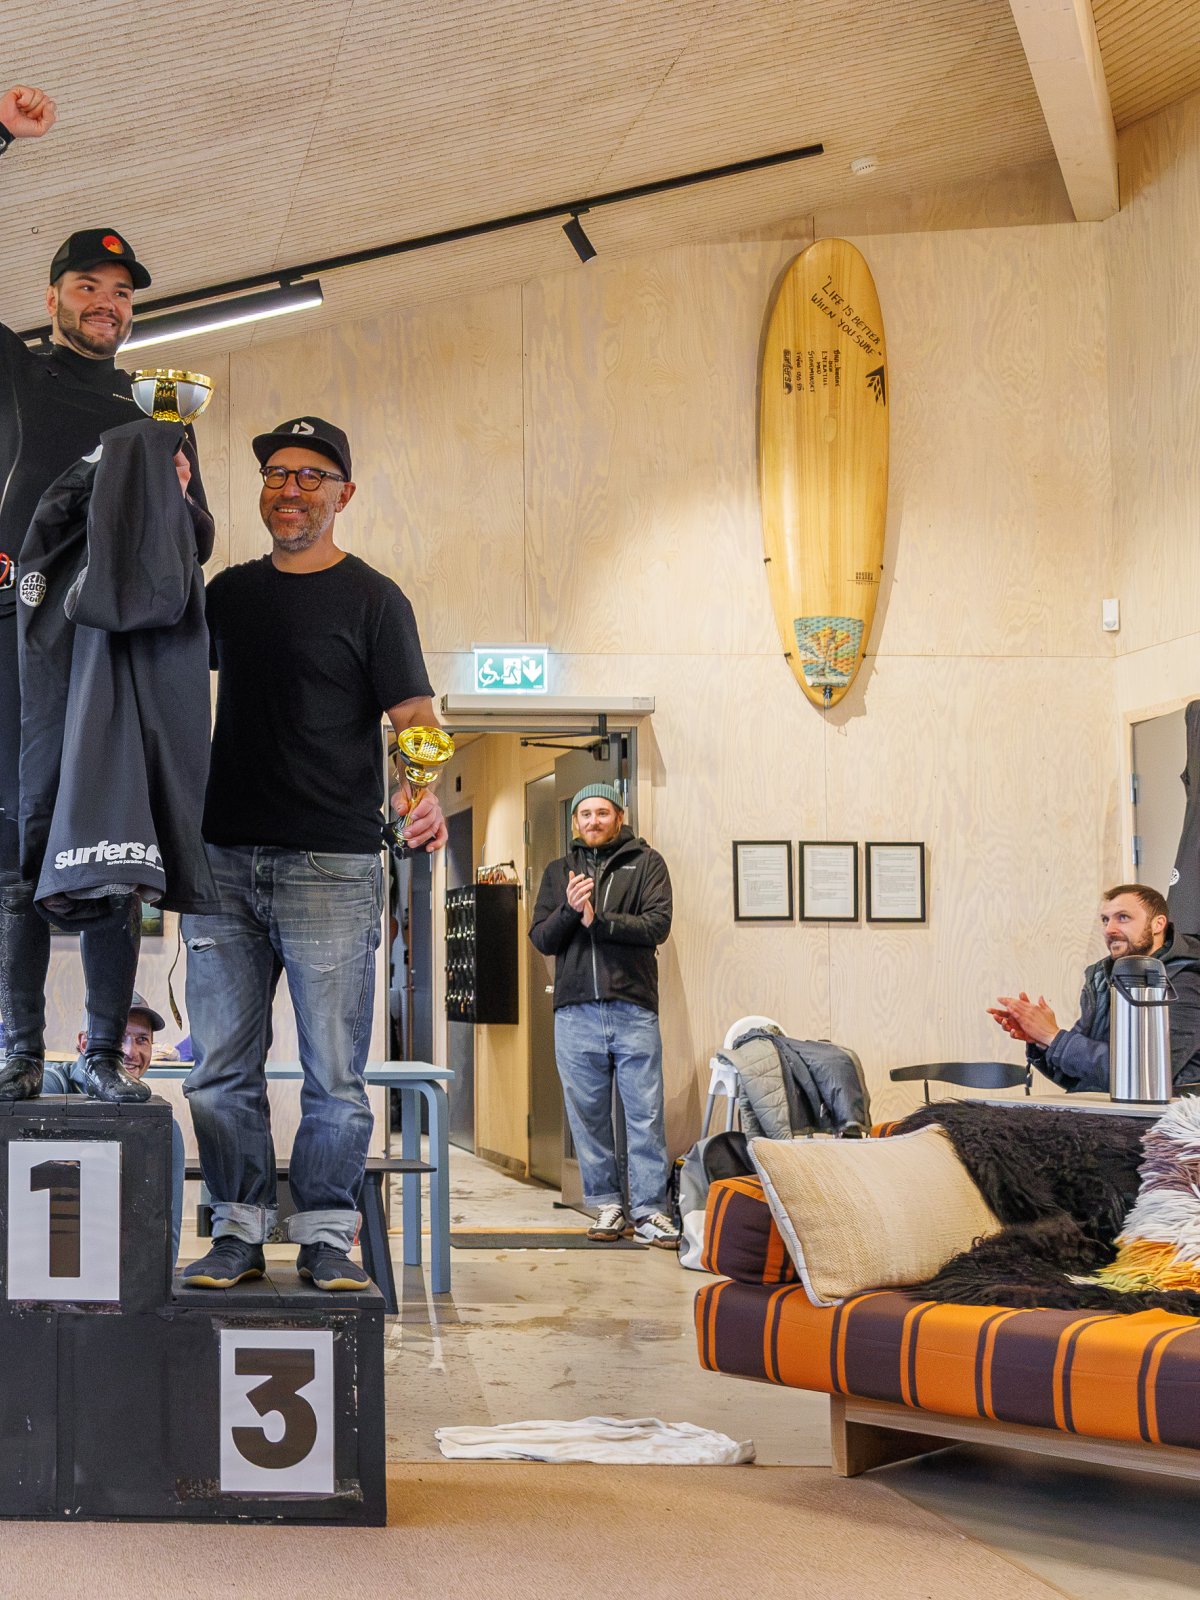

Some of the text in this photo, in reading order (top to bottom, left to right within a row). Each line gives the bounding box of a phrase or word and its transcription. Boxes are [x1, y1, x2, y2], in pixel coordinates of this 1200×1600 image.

[811, 293, 836, 319] WHEN
[838, 319, 854, 337] YOU
[843, 304, 854, 317] IS
[852, 315, 881, 345] BETTER
[54, 840, 146, 870] surfers
[29, 1160, 81, 1279] 1
[231, 1347, 317, 1470] 3
